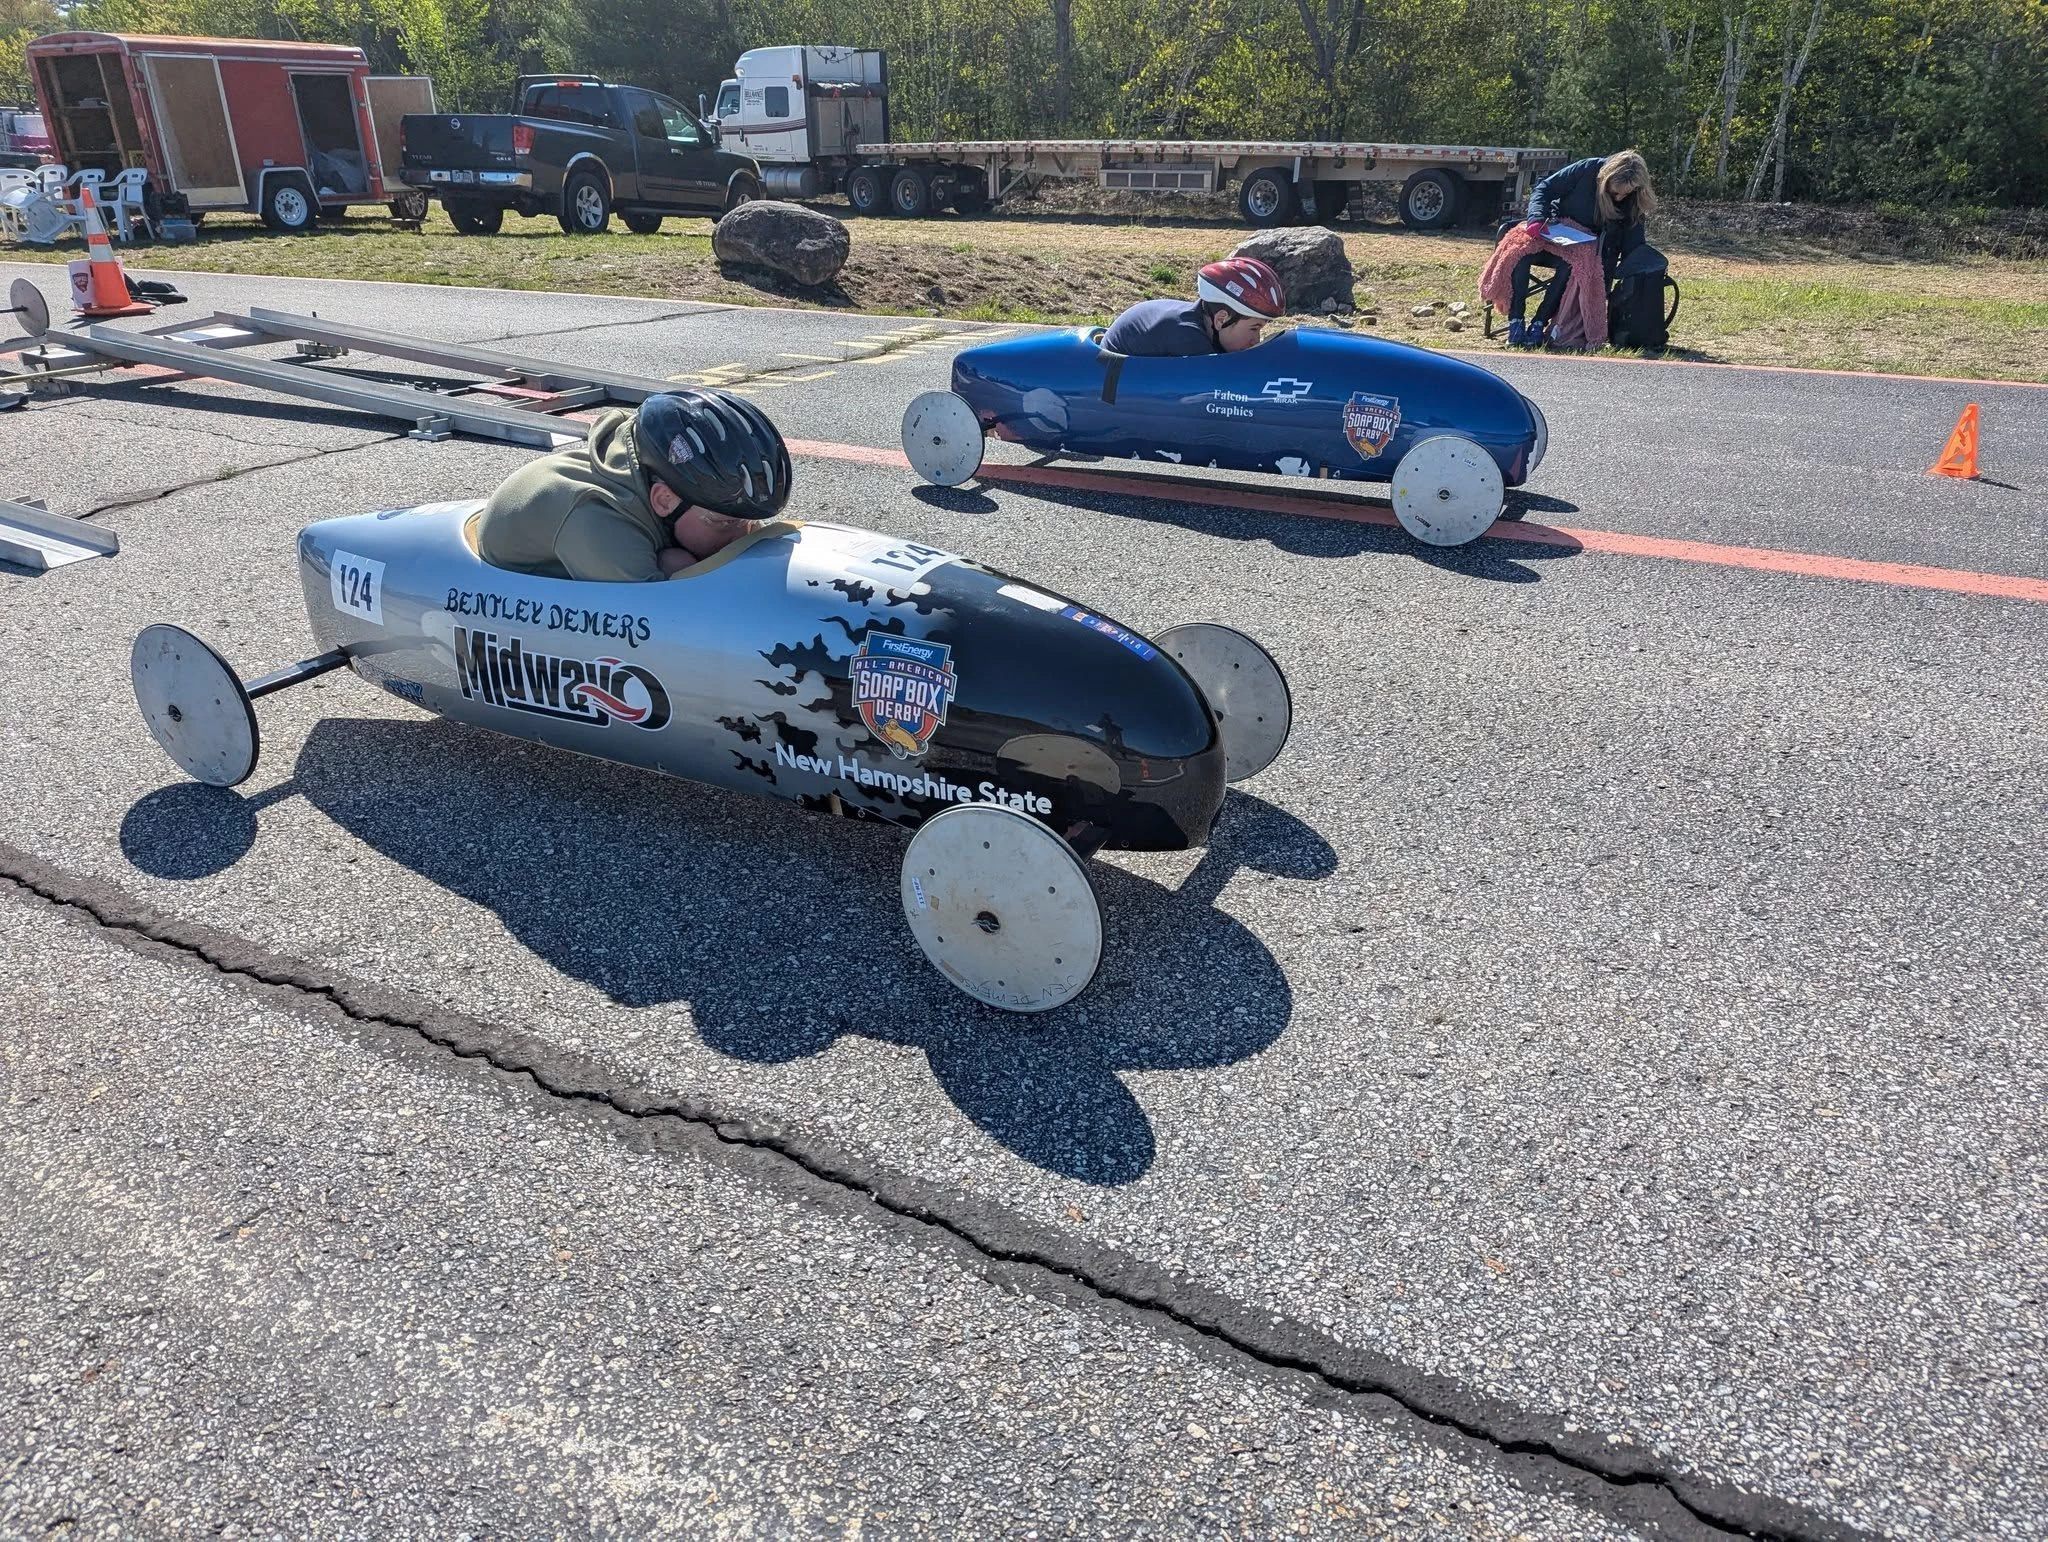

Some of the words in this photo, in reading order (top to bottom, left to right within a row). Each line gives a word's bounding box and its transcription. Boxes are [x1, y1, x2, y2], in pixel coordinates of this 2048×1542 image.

[1213, 389, 1248, 402] Falcon
[1206, 403, 1254, 417] Graphics
[1348, 413, 1372, 428] SOAP
[1373, 417, 1393, 434] BOX
[1356, 428, 1381, 440] DERBY
[871, 544, 946, 572] 124
[340, 564, 372, 612] 124
[444, 588, 543, 625] BENTLEY
[547, 604, 651, 648] DEMERS
[883, 640, 934, 659] FirstEnergy
[453, 625, 615, 728] Midway
[855, 660, 951, 688] ALL-AMERICAN
[859, 671, 904, 699] SOAP
[905, 679, 942, 714] BOX
[876, 699, 922, 723] DERBY
[775, 742, 831, 776] New
[838, 755, 972, 802] Hampshire
[978, 781, 1053, 814] State
